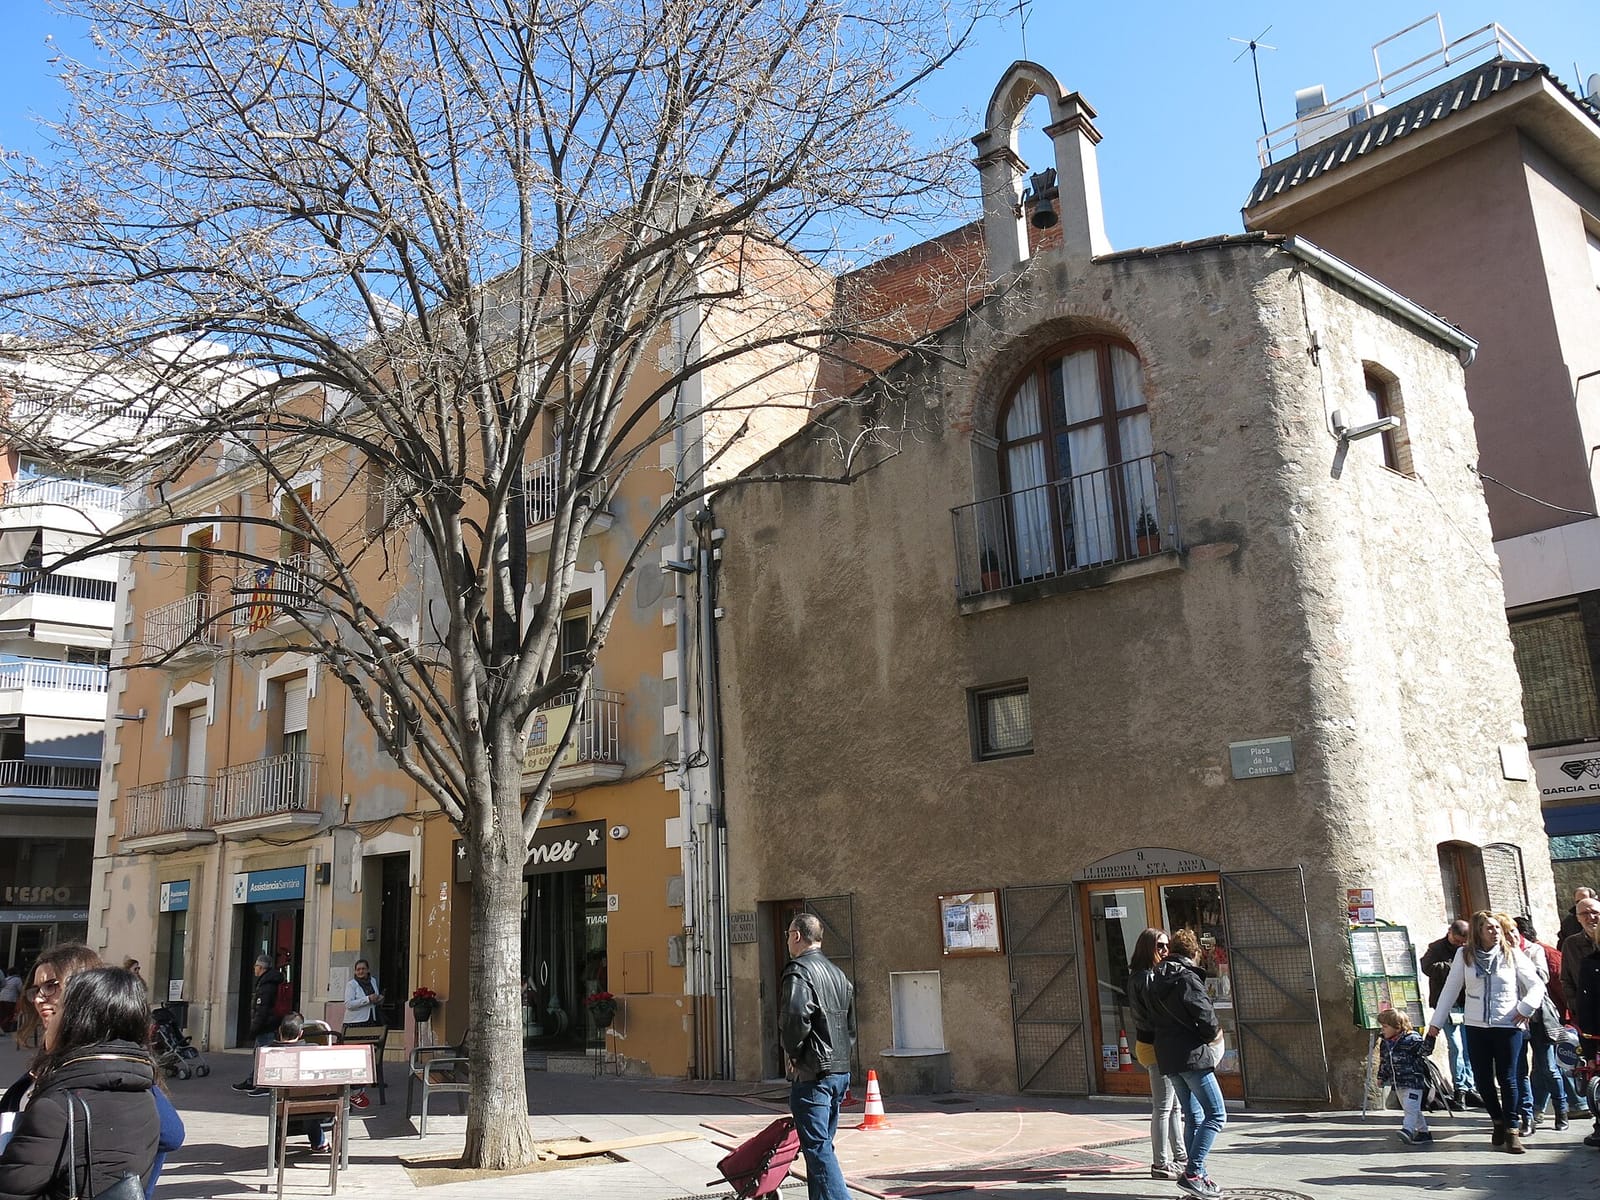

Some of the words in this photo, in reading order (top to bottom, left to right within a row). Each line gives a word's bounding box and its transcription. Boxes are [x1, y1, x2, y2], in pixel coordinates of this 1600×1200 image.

[1265, 756, 1273, 764] la
[1249, 766, 1278, 775] Caserna
[1542, 785, 1585, 794] GARCIA
[1083, 864, 1140, 879] LLIBRERIA
[1177, 859, 1207, 873] ANNA
[731, 932, 754, 942] ANNA
